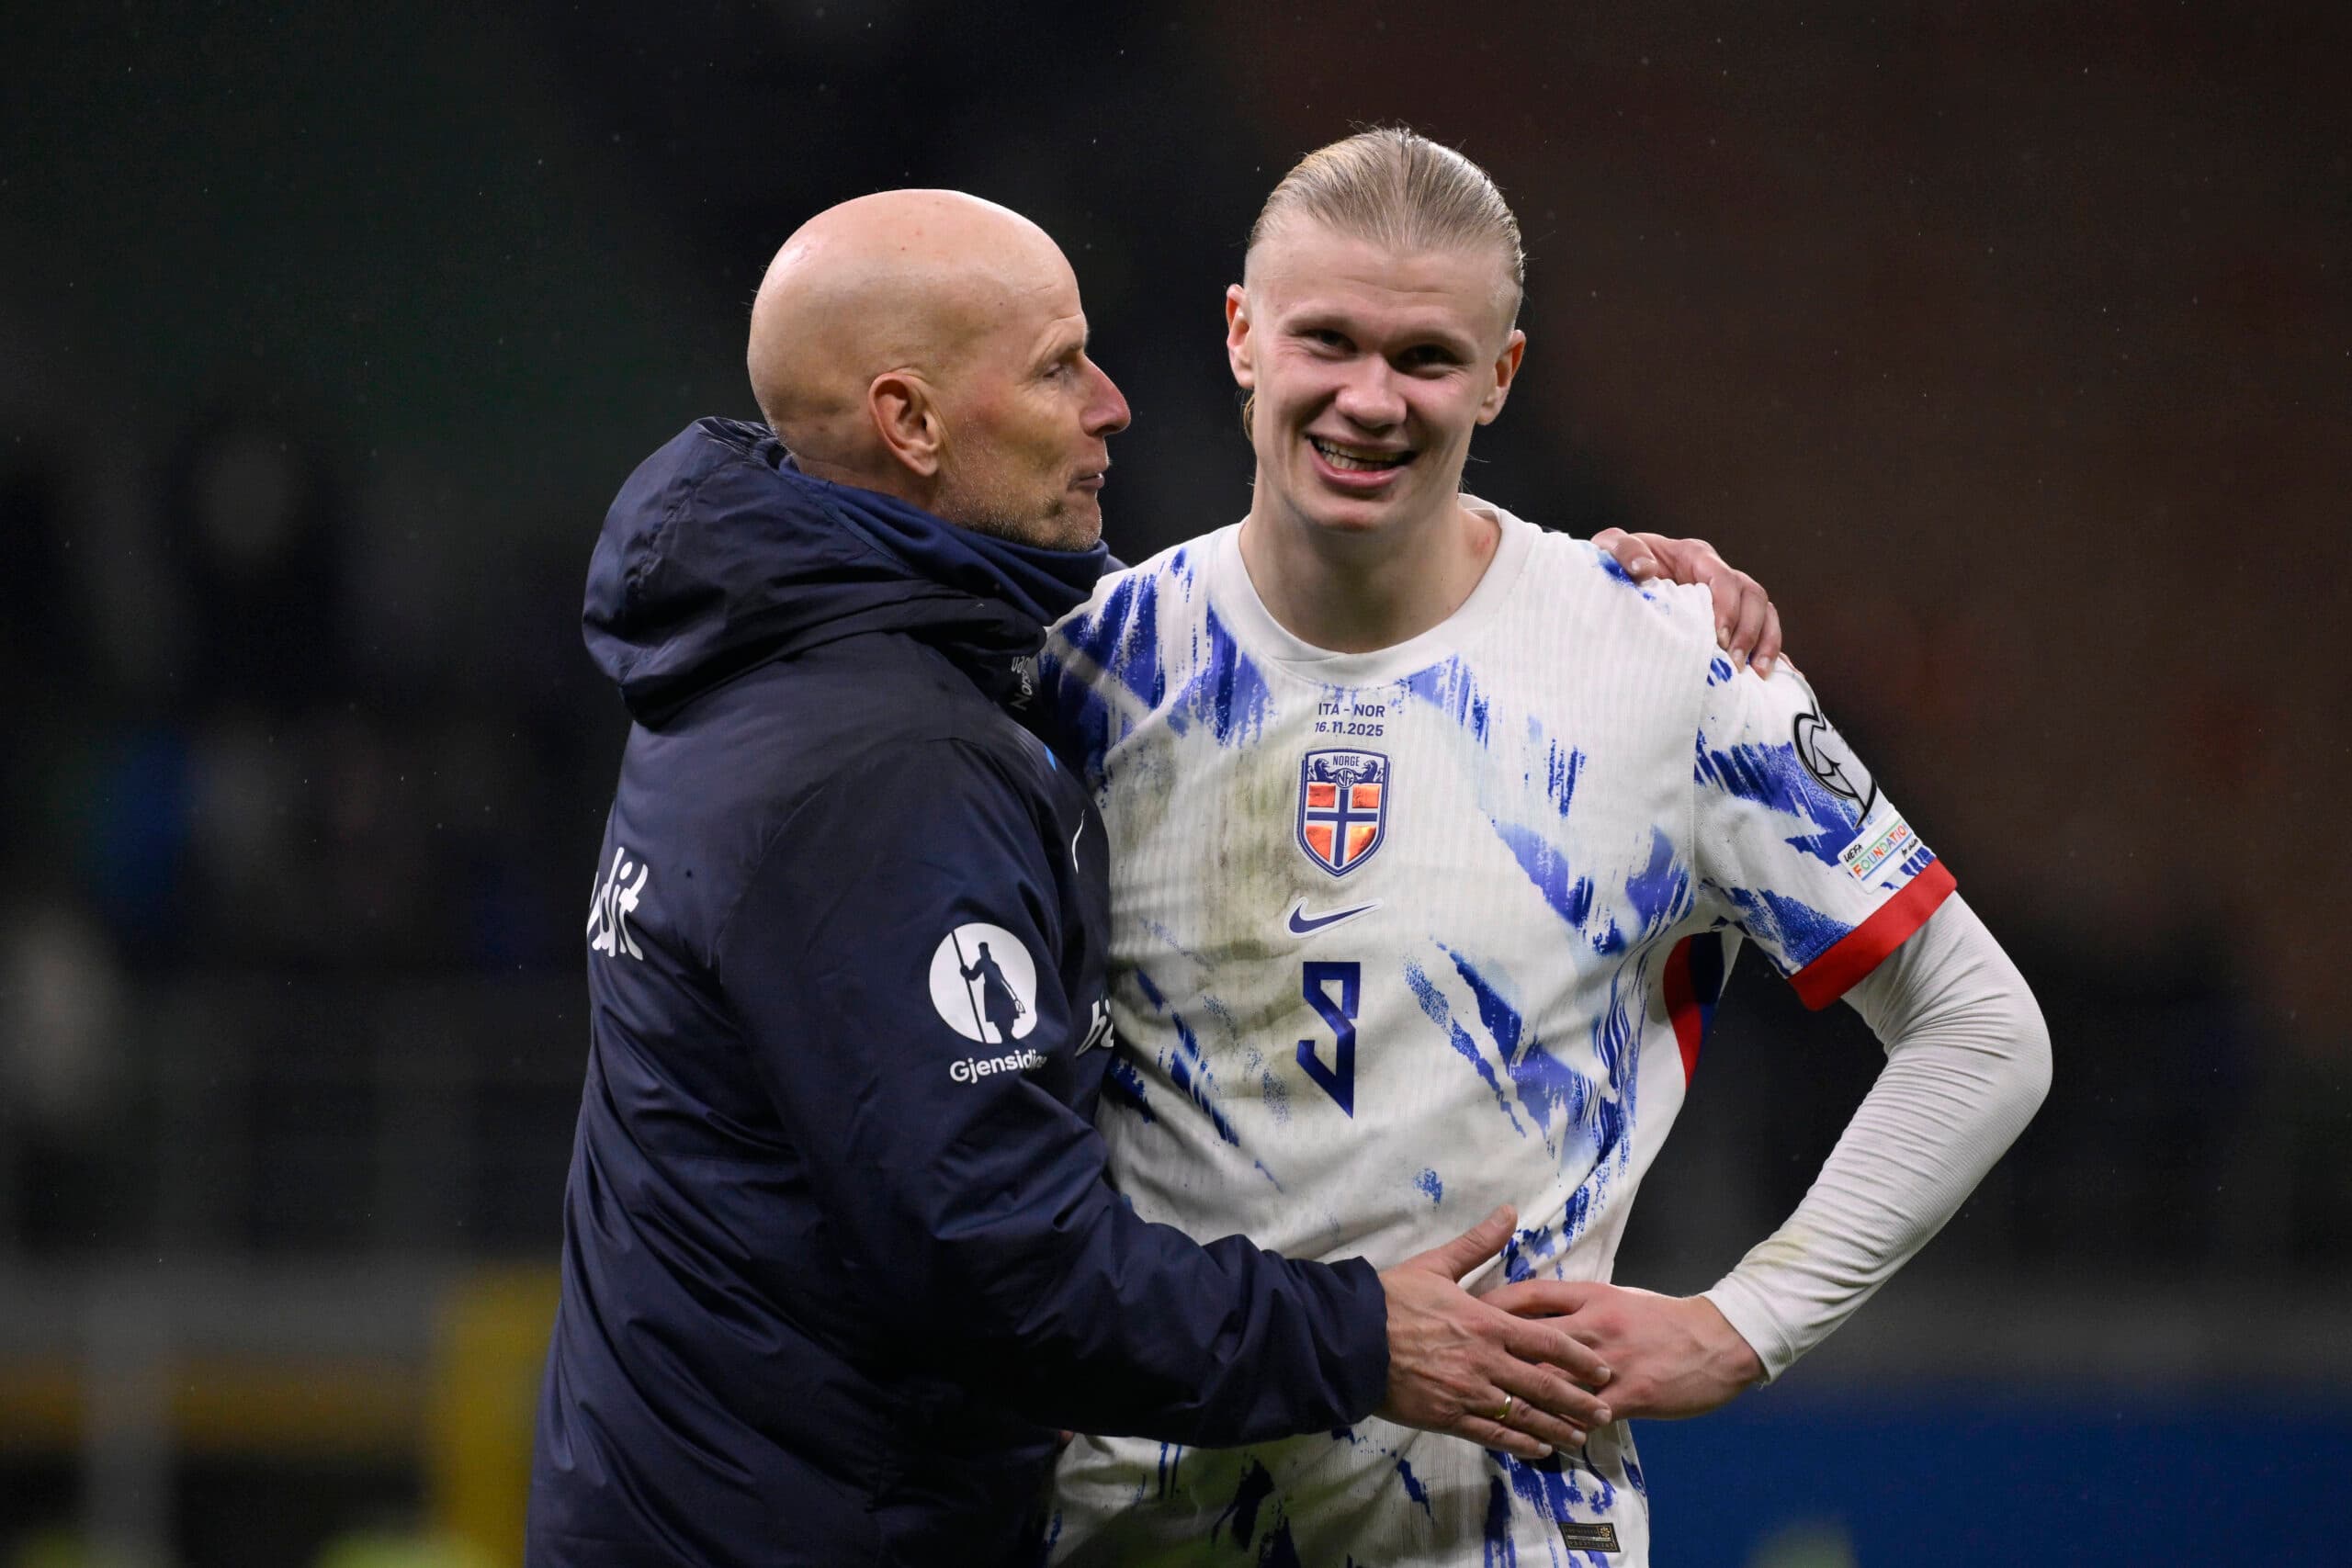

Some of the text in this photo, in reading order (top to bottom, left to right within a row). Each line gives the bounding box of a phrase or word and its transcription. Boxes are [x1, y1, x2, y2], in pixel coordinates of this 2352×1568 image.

[1317, 703, 1340, 716] ITA
[1353, 704, 1385, 718] NOR
[1314, 720, 1385, 737] 16.11.2025
[1332, 755, 1361, 768] NORGE
[1843, 842, 1863, 863] UEFA
[1295, 961, 1361, 1120] 9
